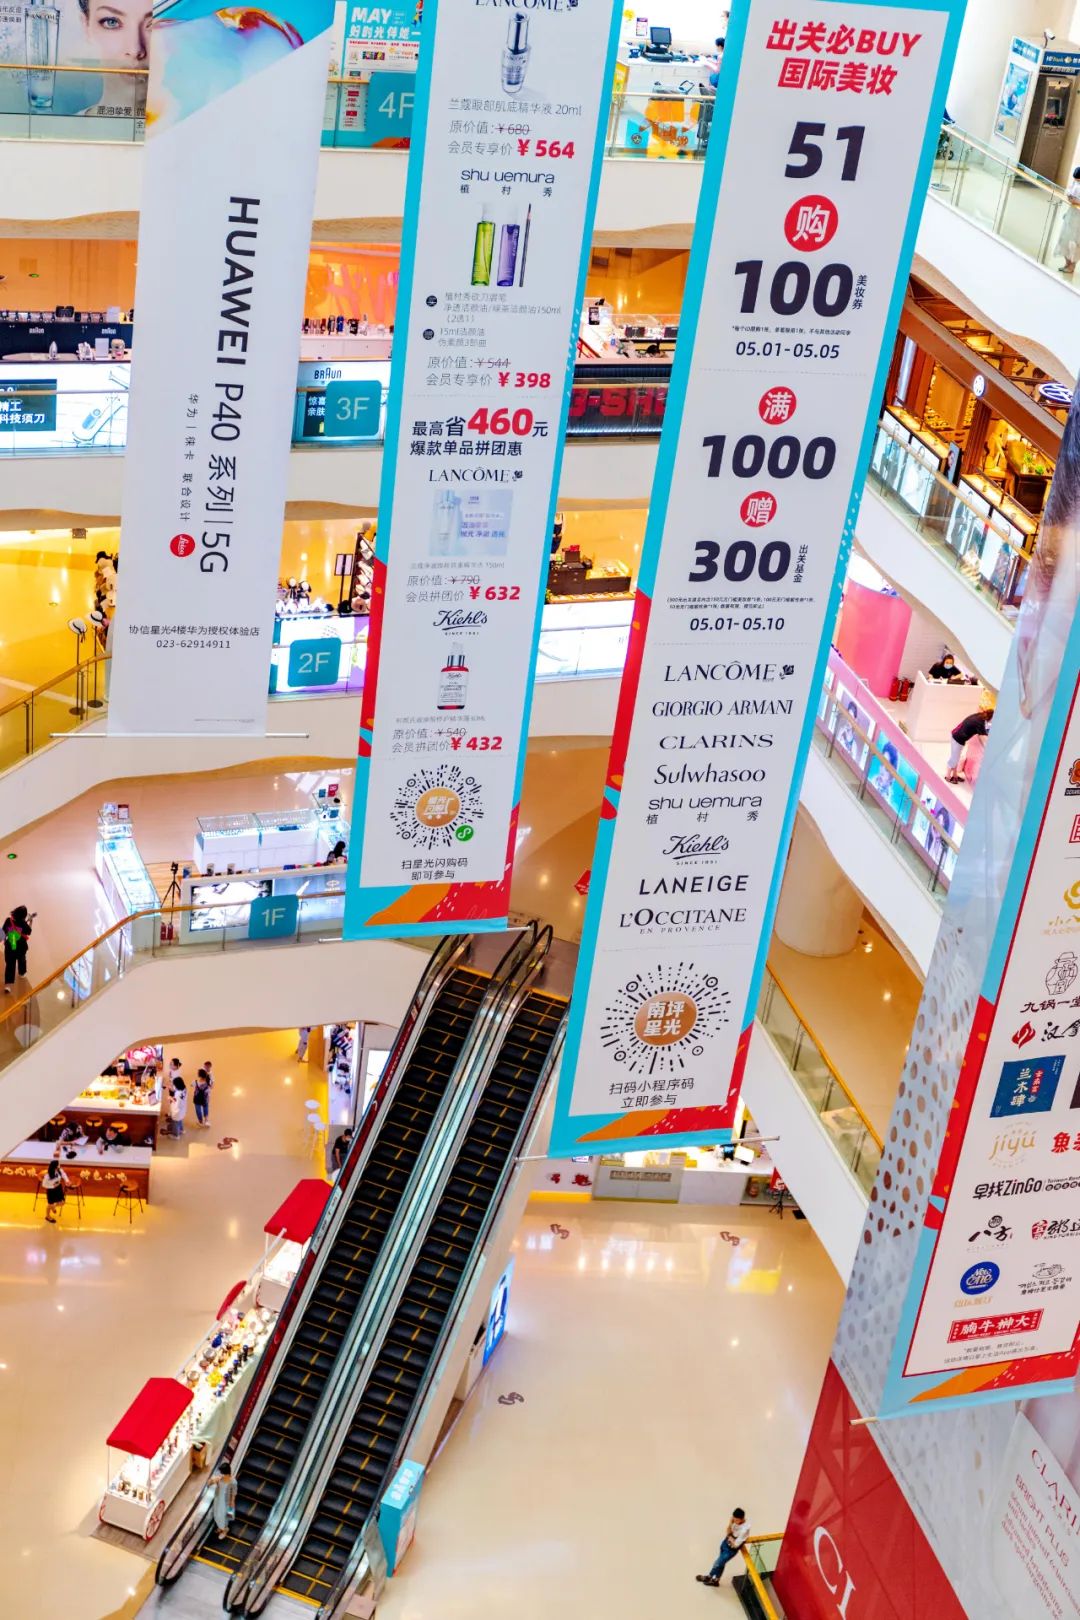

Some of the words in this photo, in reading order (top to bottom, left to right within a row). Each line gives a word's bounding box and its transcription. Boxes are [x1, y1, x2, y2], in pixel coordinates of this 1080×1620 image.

[351, 7, 392, 24] MAY
[766, 19, 922, 57] 出关必BUY
[778, 57, 898, 95] 国际美妆
[379, 92, 414, 119] 4F
[555, 104, 582, 117] 20ml
[448, 141, 512, 157] 会员专享价
[785, 121, 865, 181] 51
[461, 168, 489, 182] shu
[494, 170, 555, 184] uemura
[792, 205, 830, 242] 购
[217, 196, 260, 365] HUAWEI
[734, 260, 854, 318] 100
[736, 341, 840, 359] 05.01-05.05
[314, 368, 342, 380] BRAUN
[426, 373, 492, 387] 会员专享价
[211, 383, 244, 442] P40
[336, 399, 369, 424] 3F
[763, 392, 792, 420] 满
[412, 407, 548, 438] 最高省460元
[409, 440, 523, 457] 爆款单品拼团惠
[702, 434, 836, 480] 1000
[744, 497, 774, 524] 赠
[688, 540, 791, 583] 300
[433, 609, 488, 627] Kiehl's
[690, 617, 785, 631] 05.01-05.10
[129, 625, 260, 638] 协信星光4楼华为授权体验店
[156, 638, 231, 650] 023-62914911
[298, 652, 330, 674] 2F
[652, 701, 722, 717] GIORGIO
[727, 699, 793, 716] ARMANI
[659, 734, 773, 750] CLARINS
[654, 762, 766, 785] Sulwhasoo
[648, 796, 683, 811] shu
[689, 794, 762, 809] uemura
[662, 834, 730, 855] Kiehl's
[401, 857, 468, 870] 扫星光闪购码
[411, 870, 455, 881] 即可参与
[639, 874, 749, 895] LANEIGE
[262, 907, 286, 927] 1F
[619, 907, 747, 929] L'OCCITANE
[660, 925, 721, 935] PROVENCE
[643, 1019, 682, 1037] 星光
[609, 1077, 694, 1096] 扫码小程序码
[620, 1093, 677, 1109] 立即参与
[1046, 1525, 1069, 1567] PLUS
